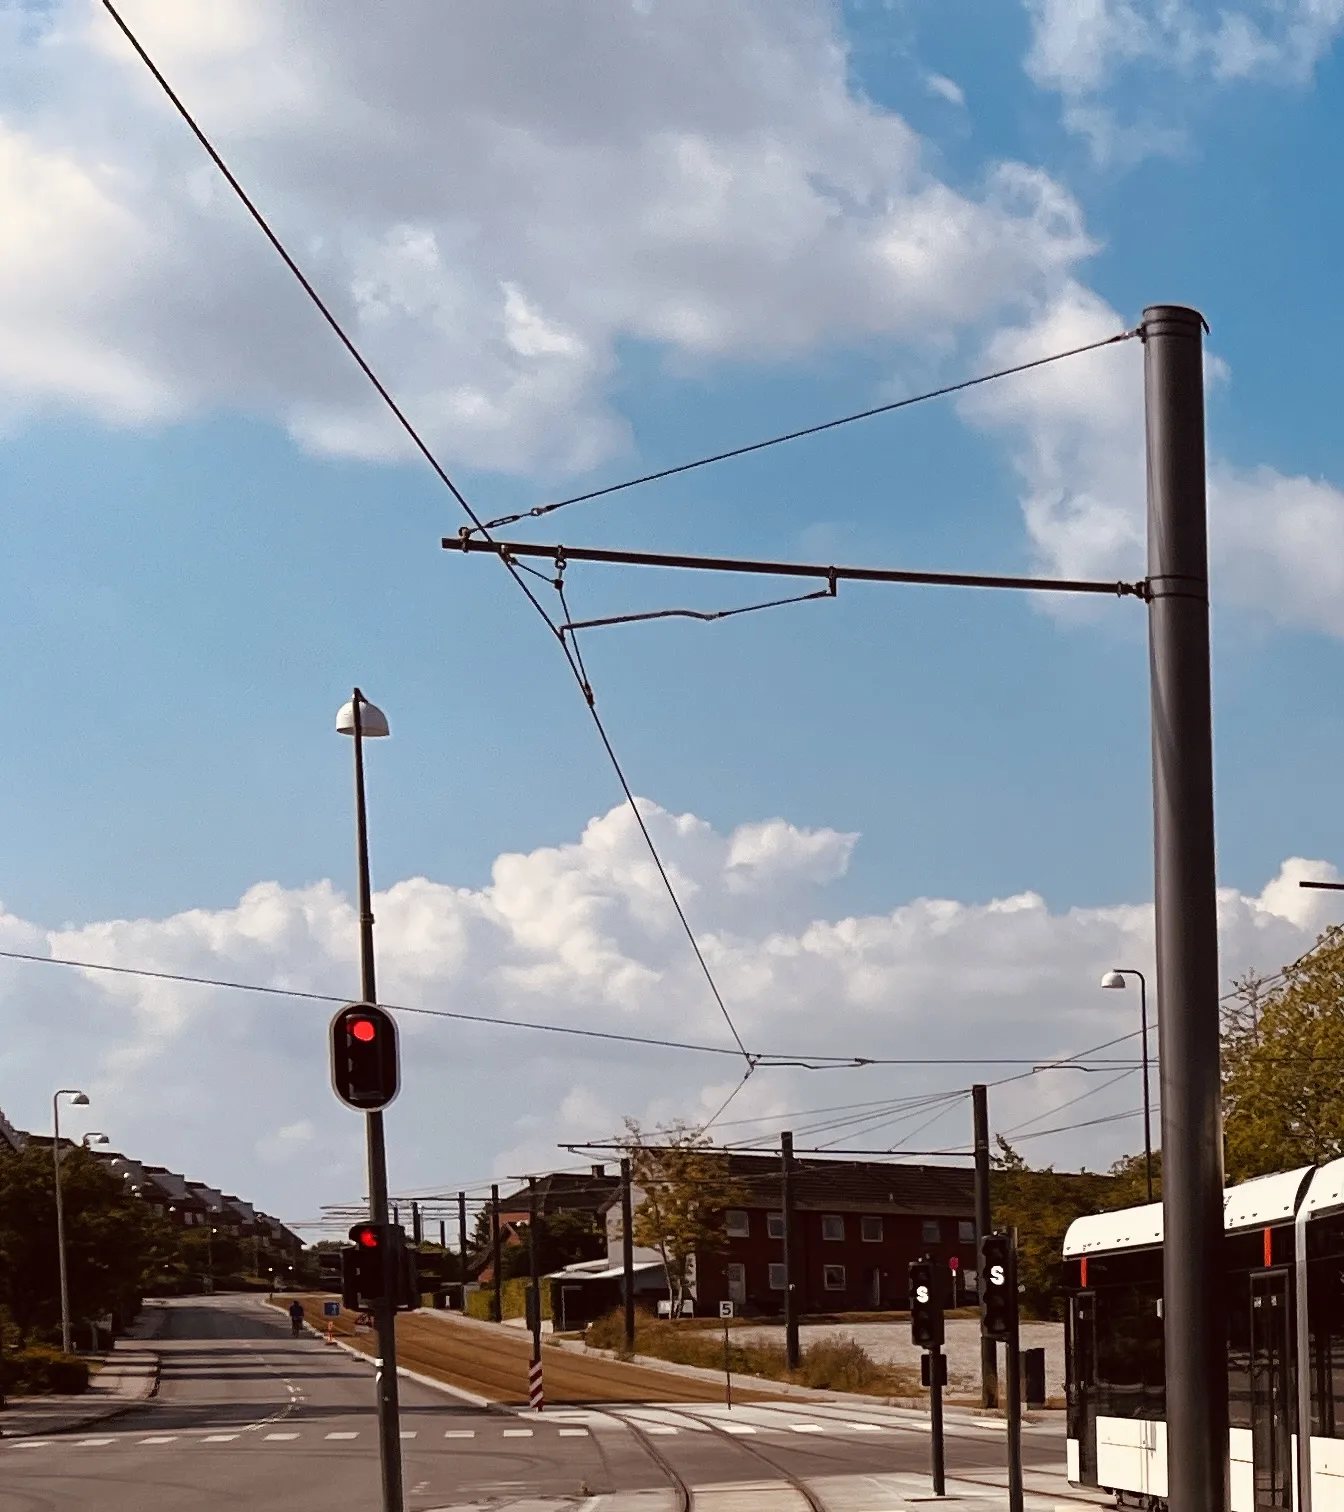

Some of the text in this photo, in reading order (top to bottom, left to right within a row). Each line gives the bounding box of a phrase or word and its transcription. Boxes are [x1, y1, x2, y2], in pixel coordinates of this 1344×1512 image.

[990, 1265, 1005, 1286] S
[916, 1285, 929, 1303] S
[721, 1303, 732, 1316] 5
